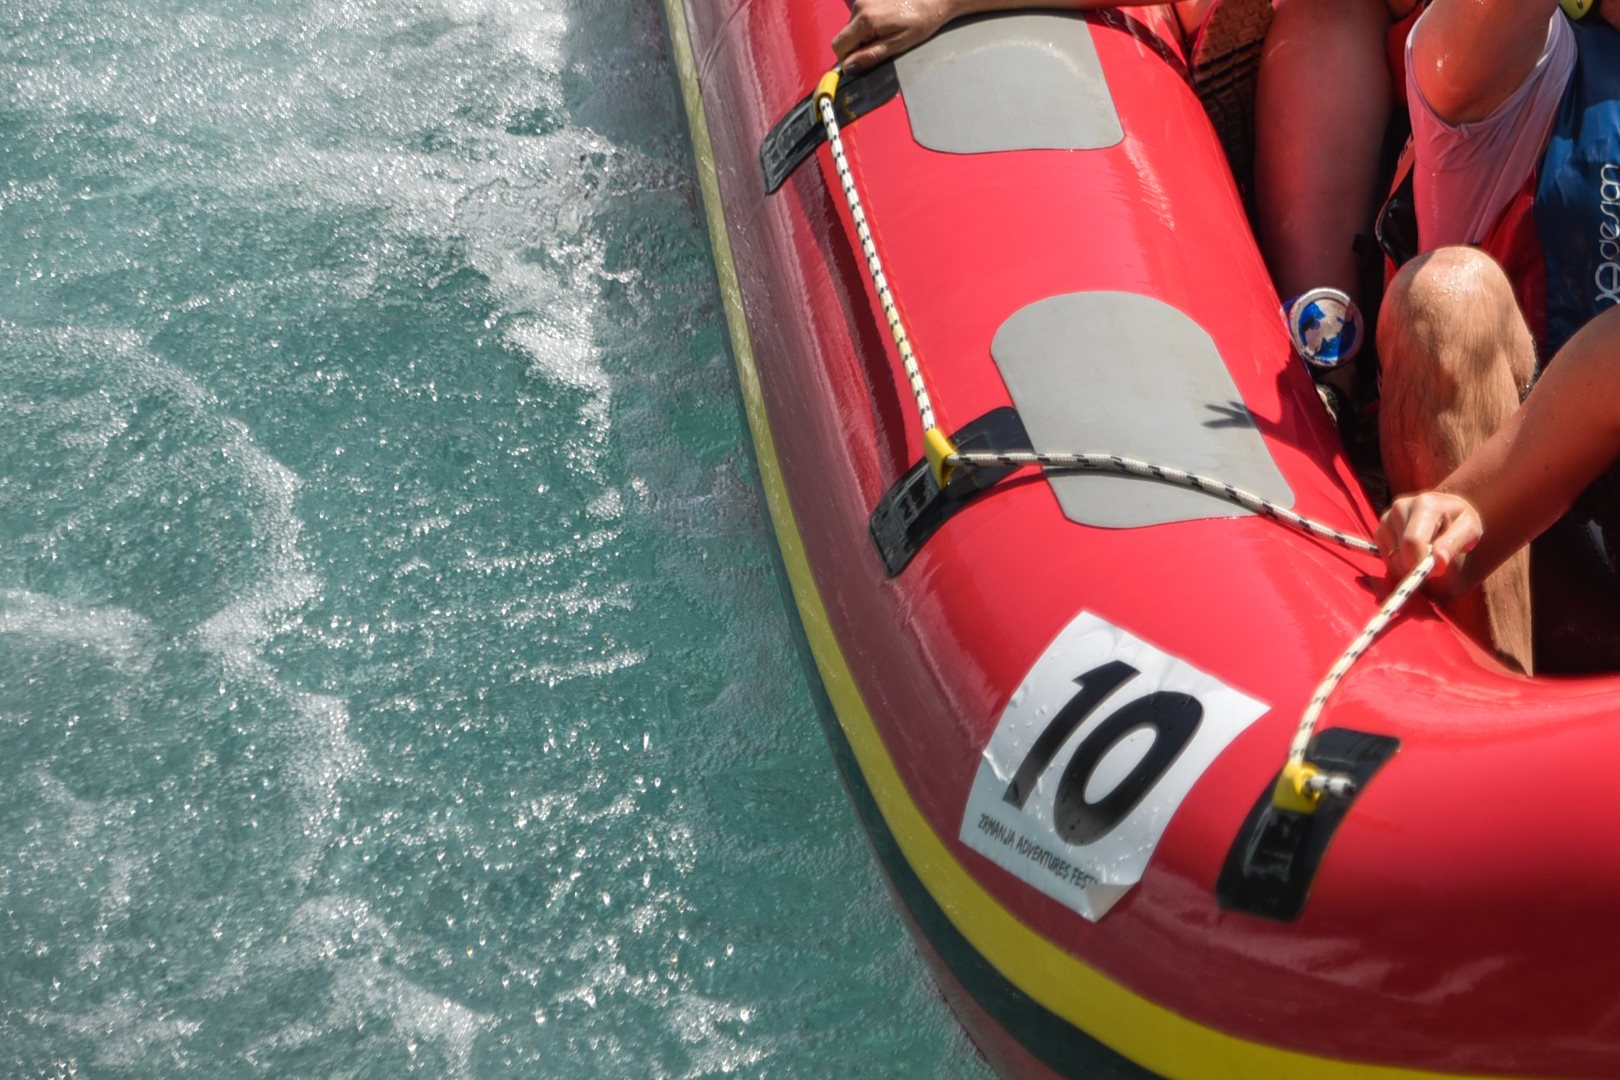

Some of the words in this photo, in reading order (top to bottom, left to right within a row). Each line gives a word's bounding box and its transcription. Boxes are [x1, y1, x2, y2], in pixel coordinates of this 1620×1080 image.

[1002, 660, 1204, 846] 10
[977, 813, 1015, 847] ZRMANJA
[1016, 836, 1071, 880] ADVENTURES
